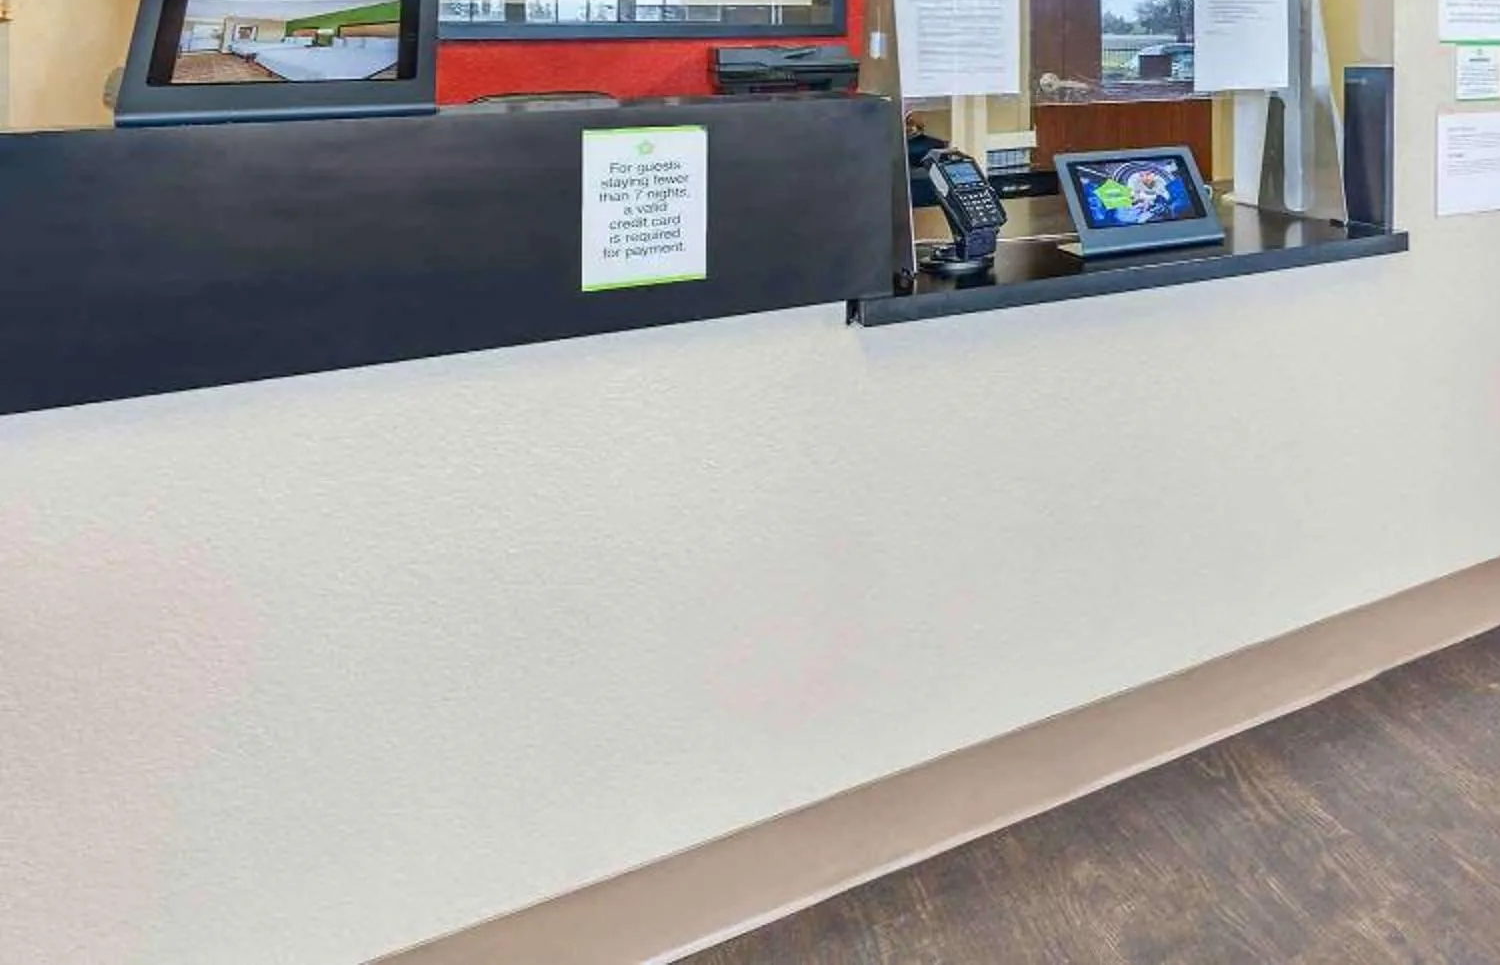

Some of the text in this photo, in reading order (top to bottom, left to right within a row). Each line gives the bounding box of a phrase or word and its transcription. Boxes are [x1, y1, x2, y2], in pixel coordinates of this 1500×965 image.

[609, 160, 681, 175] For guests
[601, 174, 689, 189] staying fewer
[599, 191, 629, 202] than
[634, 190, 642, 201] 7
[623, 201, 668, 215] a valid
[609, 214, 681, 230] credit card
[609, 228, 681, 244] is required
[604, 247, 621, 259] for
